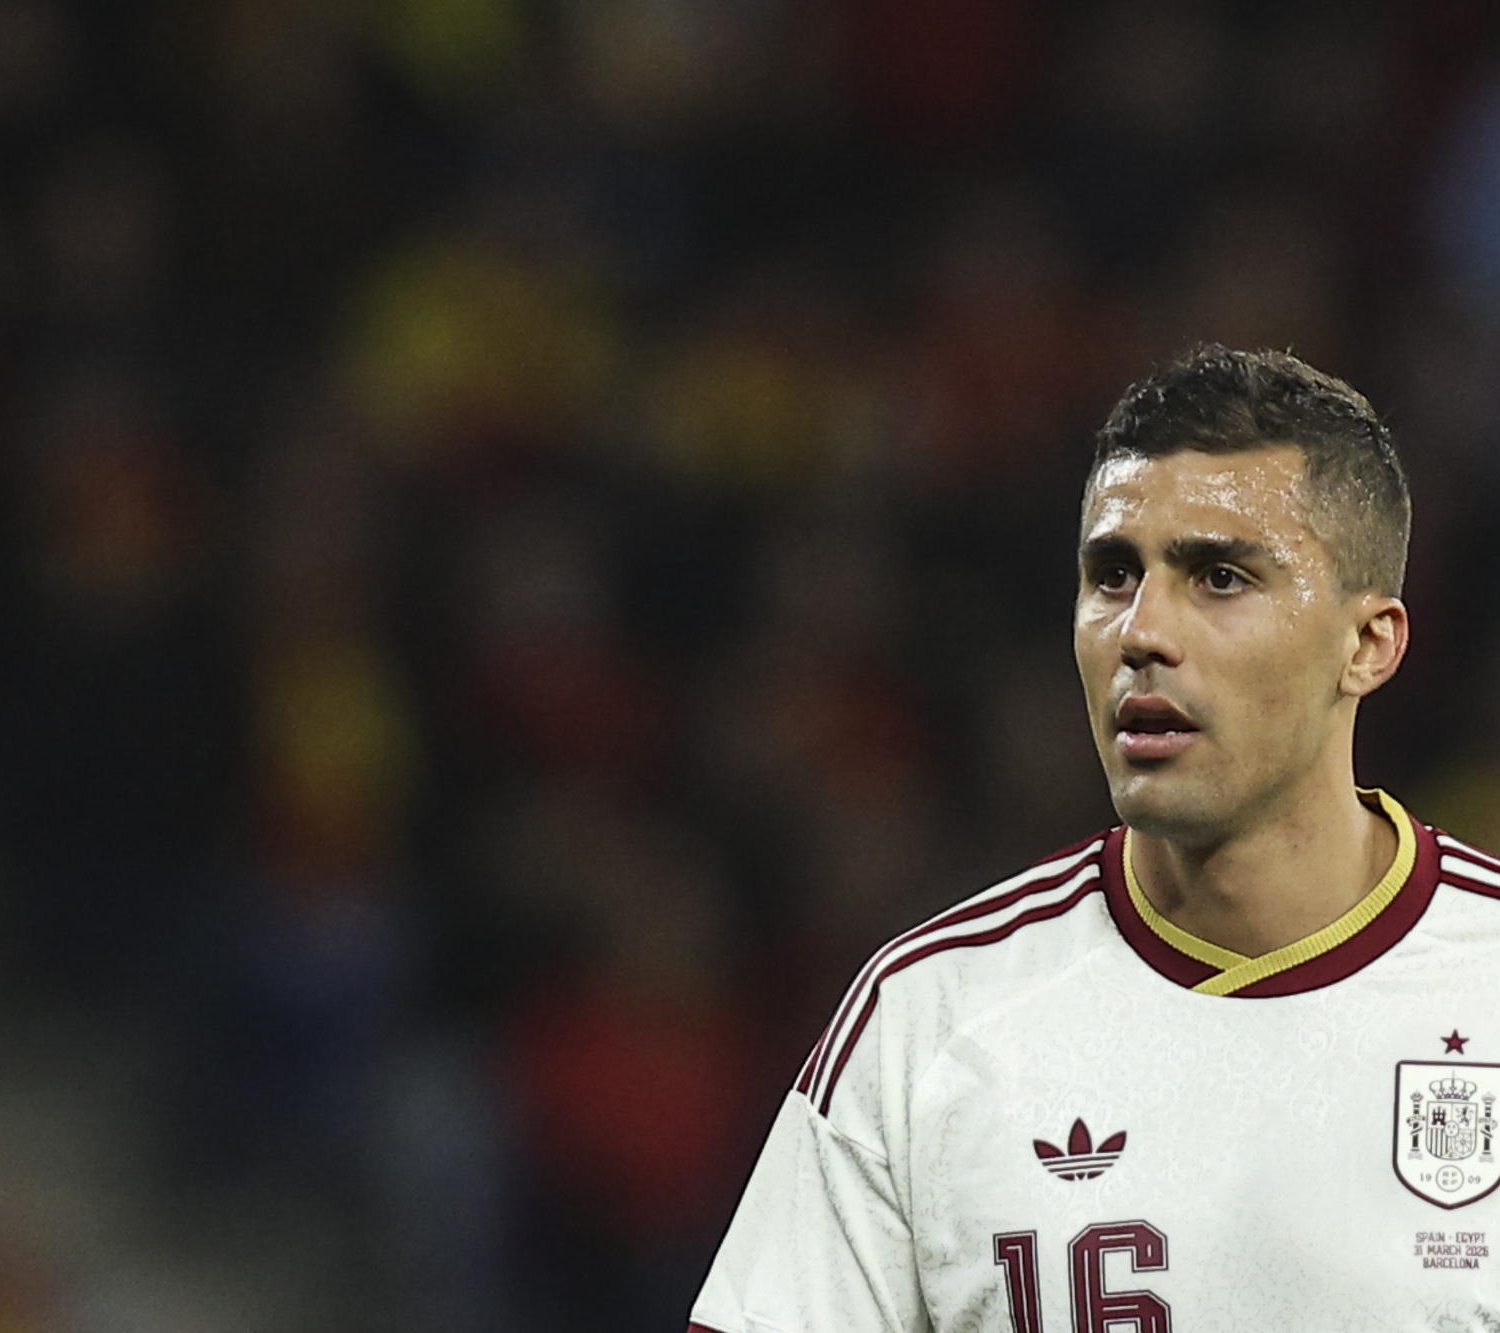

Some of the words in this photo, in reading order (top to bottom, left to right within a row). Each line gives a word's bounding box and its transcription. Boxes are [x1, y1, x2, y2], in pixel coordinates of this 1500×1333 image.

[1415, 1232, 1445, 1243] SPAIN
[1456, 1232, 1485, 1243] EGYPT
[1413, 1245, 1423, 1256] 31
[1427, 1245, 1461, 1255] MARCH
[1465, 1245, 1489, 1257] 2026
[1423, 1258, 1479, 1269] BARCELONA
